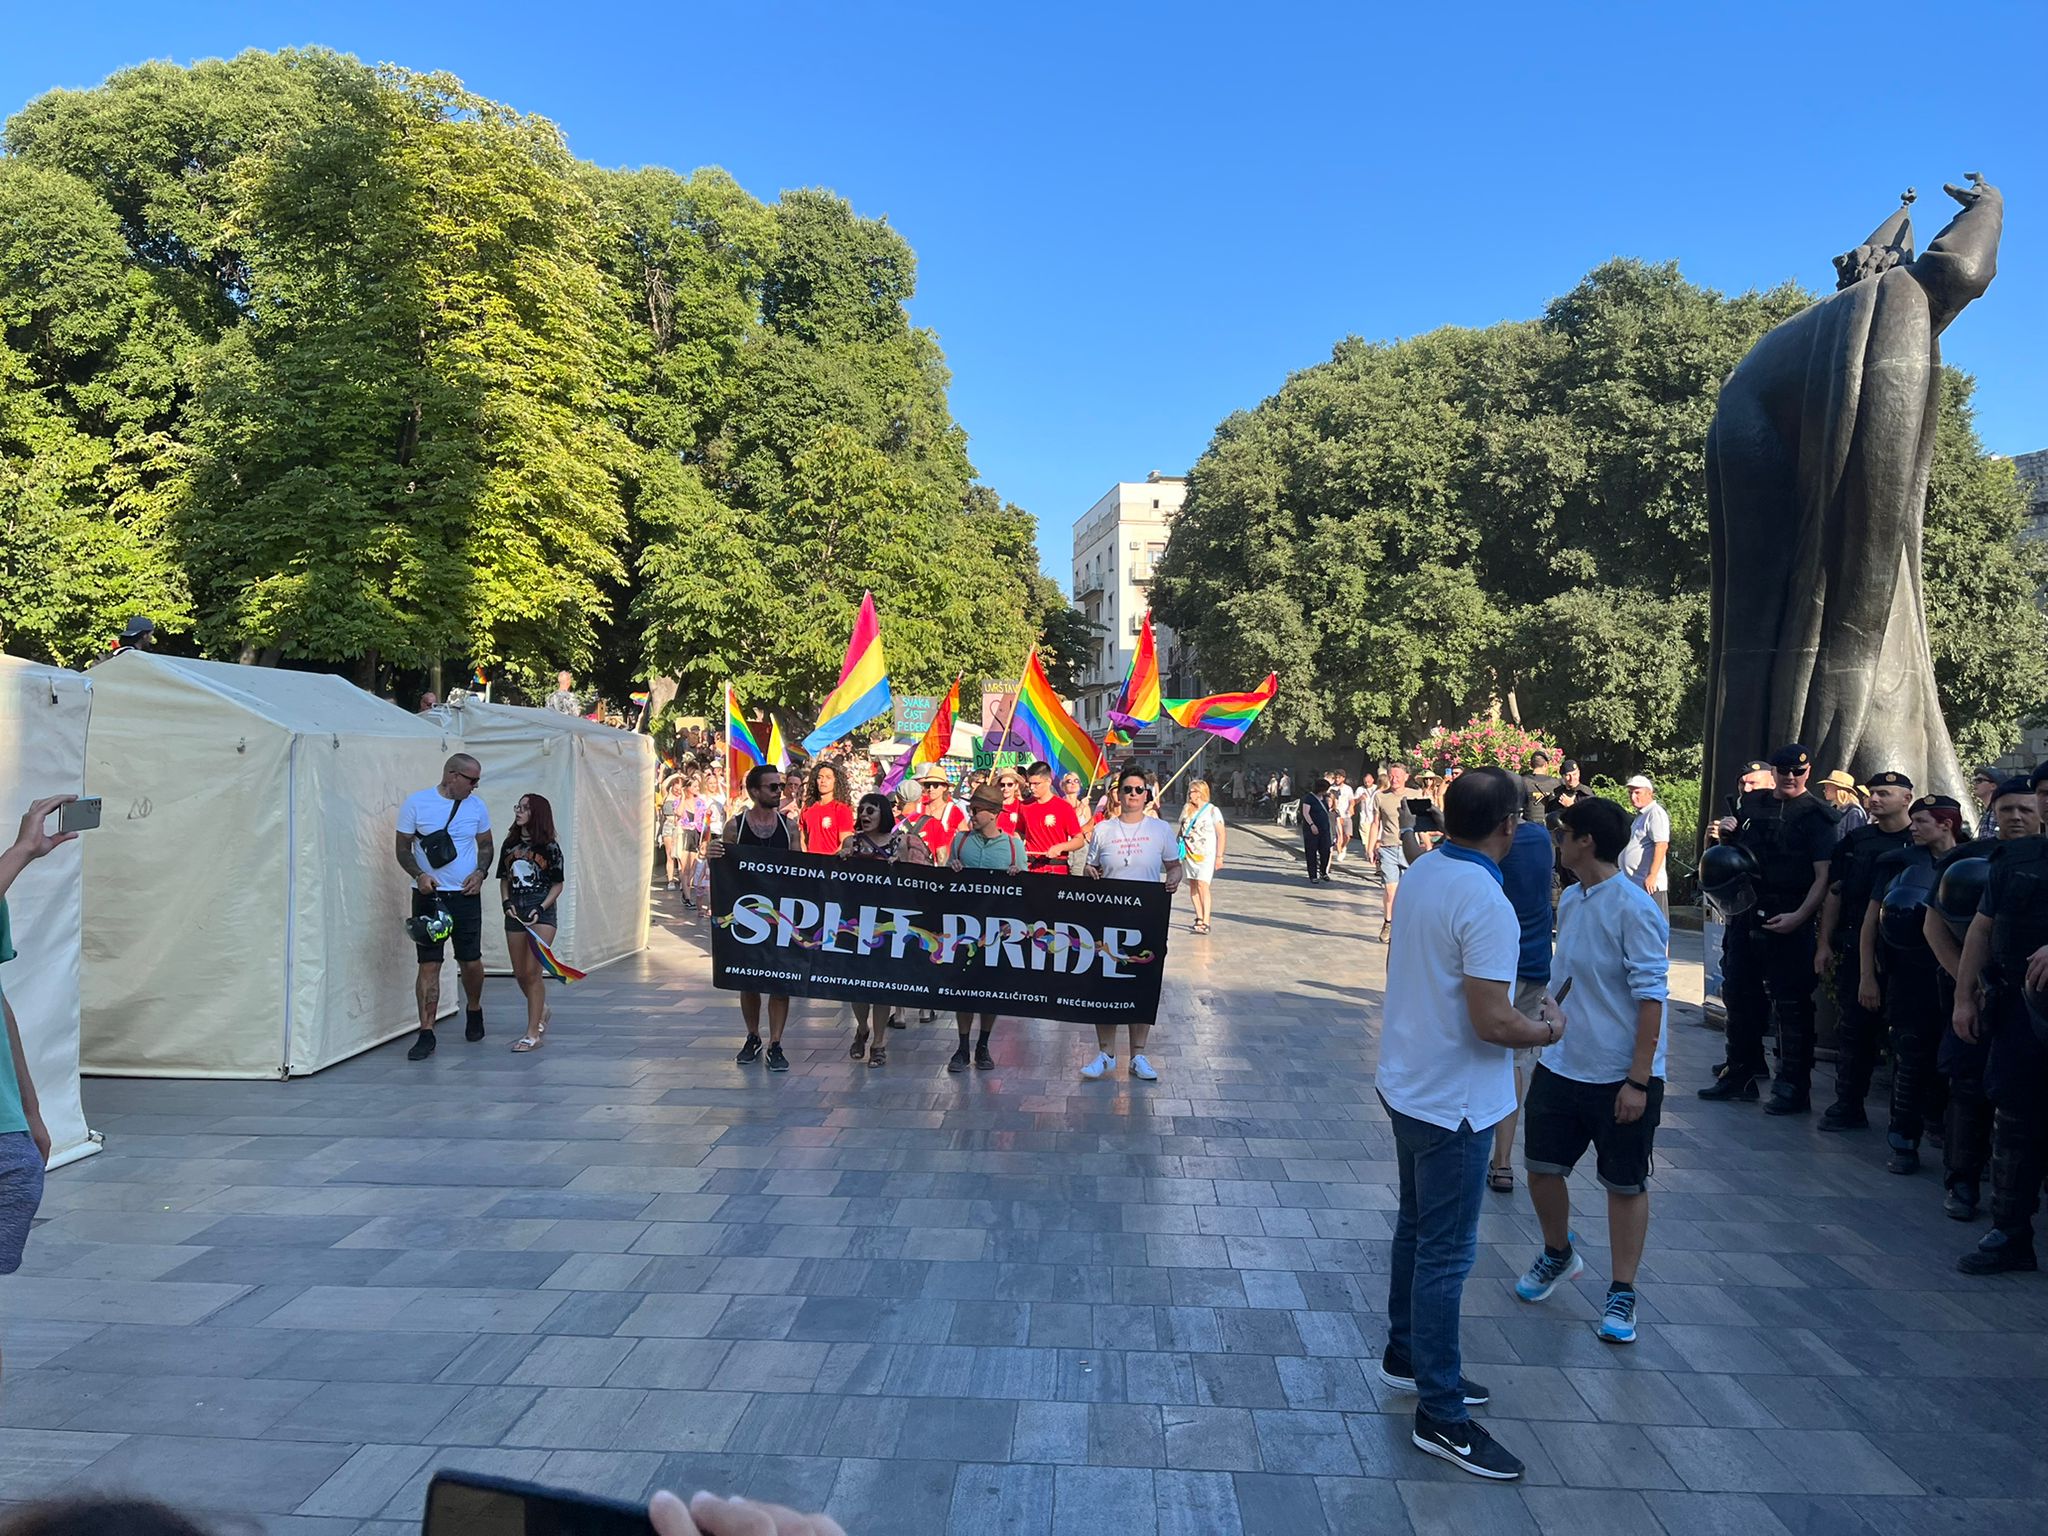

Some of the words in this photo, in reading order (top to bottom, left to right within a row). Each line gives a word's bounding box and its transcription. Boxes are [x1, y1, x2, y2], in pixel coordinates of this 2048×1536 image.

[902, 697, 931, 708] SVAKA
[739, 861, 826, 879] PROSVJEDNA
[830, 870, 892, 886] POVORKA
[897, 877, 945, 892] LGBTIQ+
[949, 882, 1023, 896] ZAJEDNICE
[1057, 890, 1142, 906] #AMOVANKA
[730, 894, 924, 959] SPLIT
[725, 966, 802, 981] #MASUPONOSNI
[810, 974, 930, 993] #KONTRAPREDRASUDAMA
[938, 987, 1048, 1003] #SLAVIMORAZLIČITOSTI
[1056, 997, 1136, 1009] #NEĆEMOU4ZIDA
